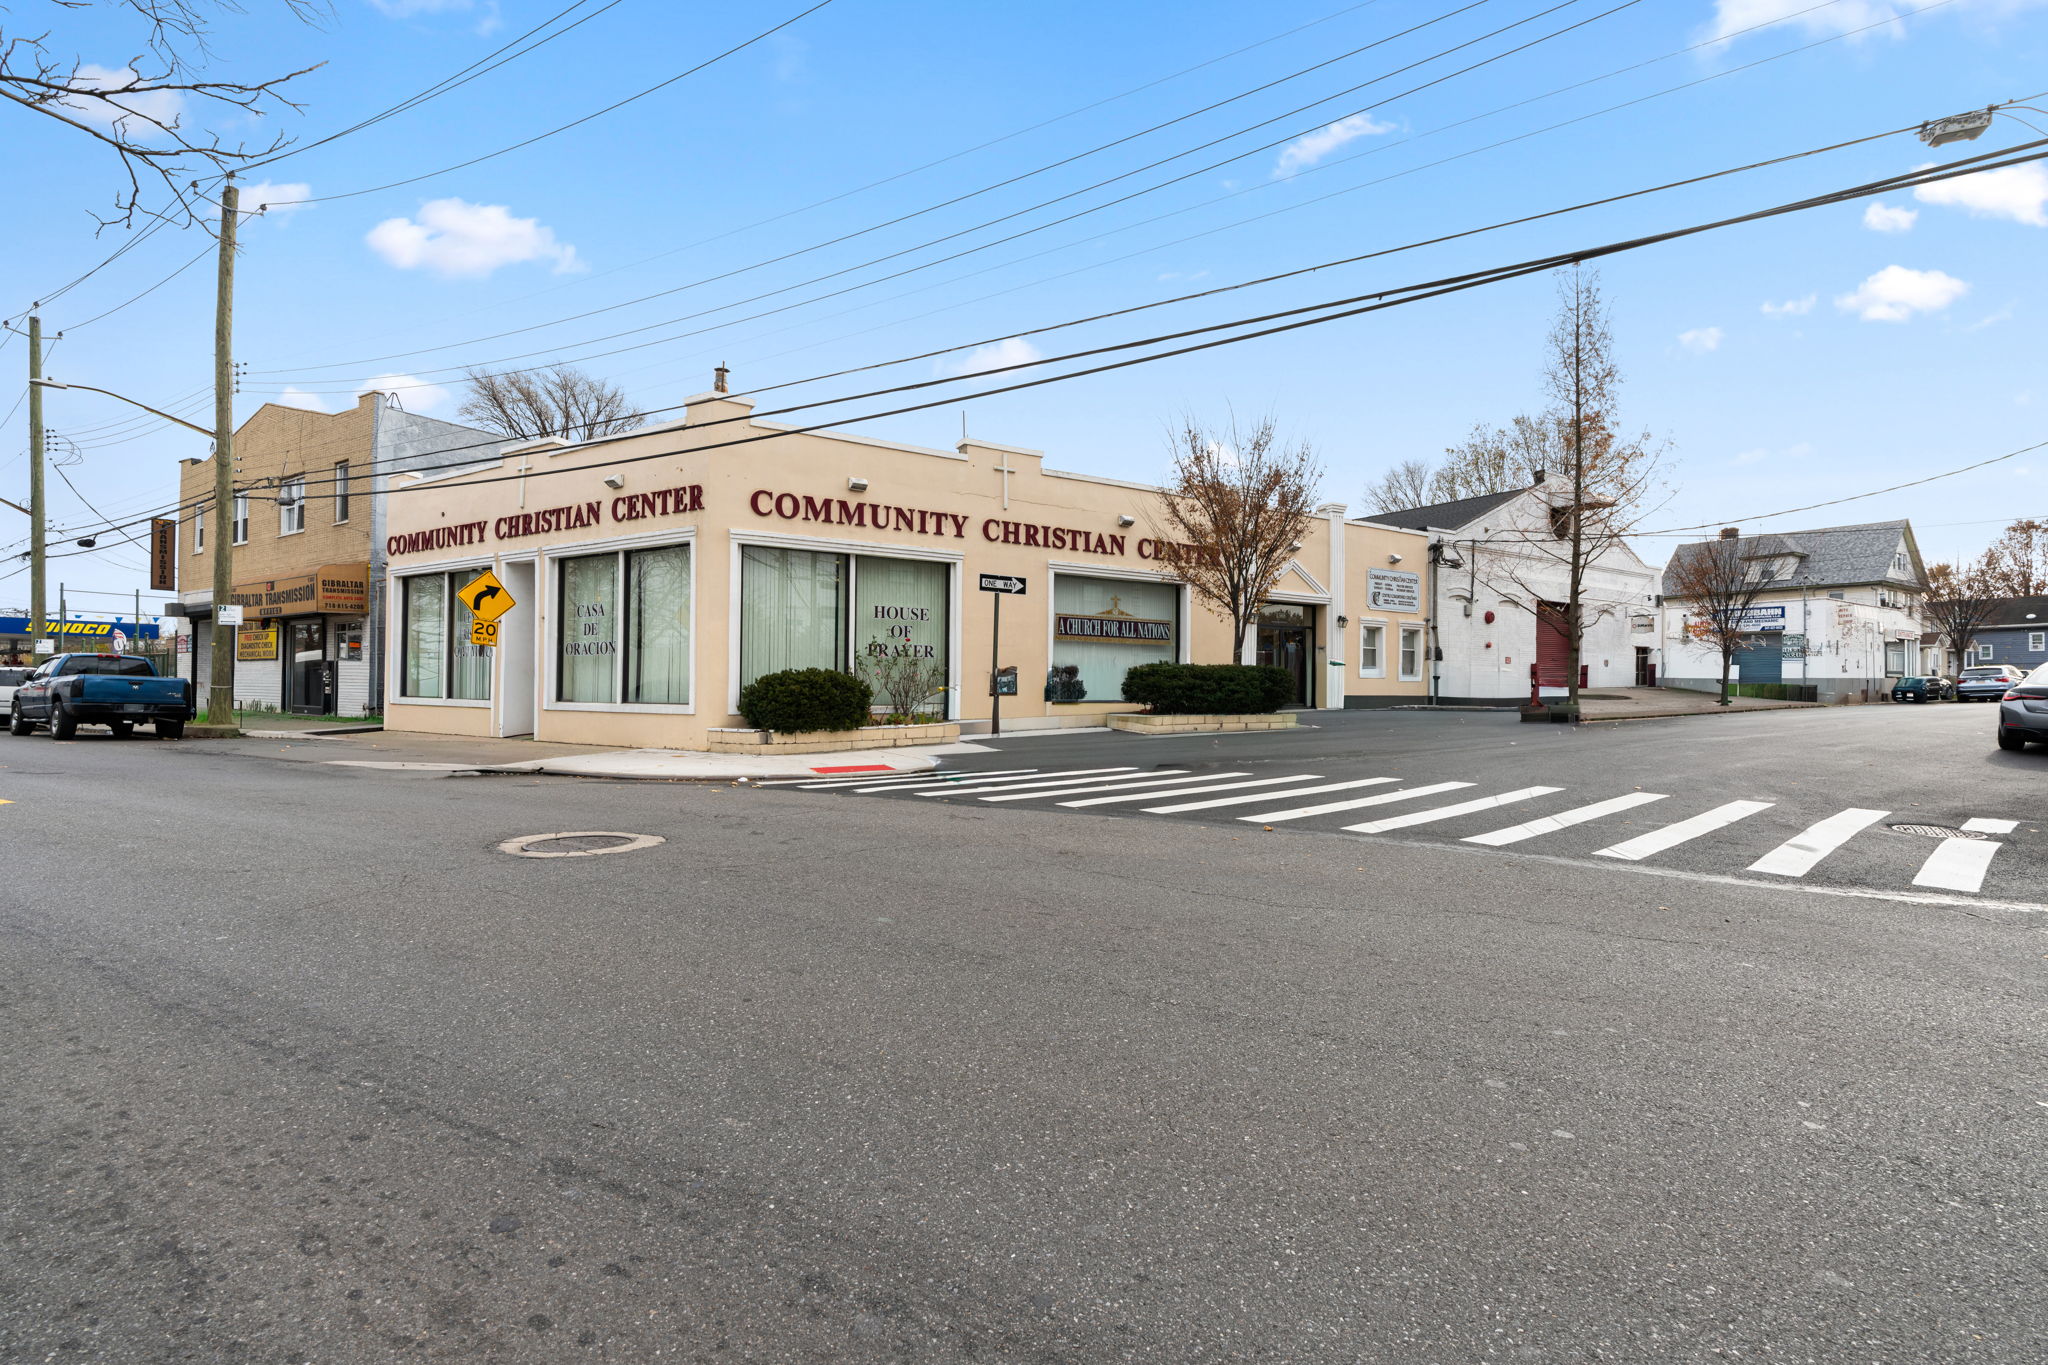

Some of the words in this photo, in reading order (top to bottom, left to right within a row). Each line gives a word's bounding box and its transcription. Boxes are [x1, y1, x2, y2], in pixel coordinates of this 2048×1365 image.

[386, 520, 488, 556] COMMUNITY
[494, 500, 602, 540] CHRISTIAN
[611, 484, 705, 522] CENTER
[750, 489, 969, 538] COMMUNITY
[982, 518, 1126, 556] CHRISTIAN
[321, 579, 364, 588] GIBRALTAR
[984, 579, 998, 588] ONE
[1003, 580, 1017, 589] WAY
[231, 593, 263, 608] GIBRALTAR
[265, 583, 315, 606] TRANSMISSION
[322, 587, 364, 595] TRANSMISSION
[577, 603, 605, 617] CASA
[874, 605, 929, 621] HOUSE
[474, 622, 496, 636] 20
[584, 622, 598, 636] DE
[890, 625, 912, 638] OF
[1059, 618, 1065, 634] A
[1066, 618, 1100, 636] CHURCH
[1103, 620, 1119, 637] FOR
[1121, 621, 1137, 638] ALL
[1138, 622, 1170, 639] NATIONS
[566, 641, 616, 656] ORACION
[867, 643, 934, 658] PRAYER
